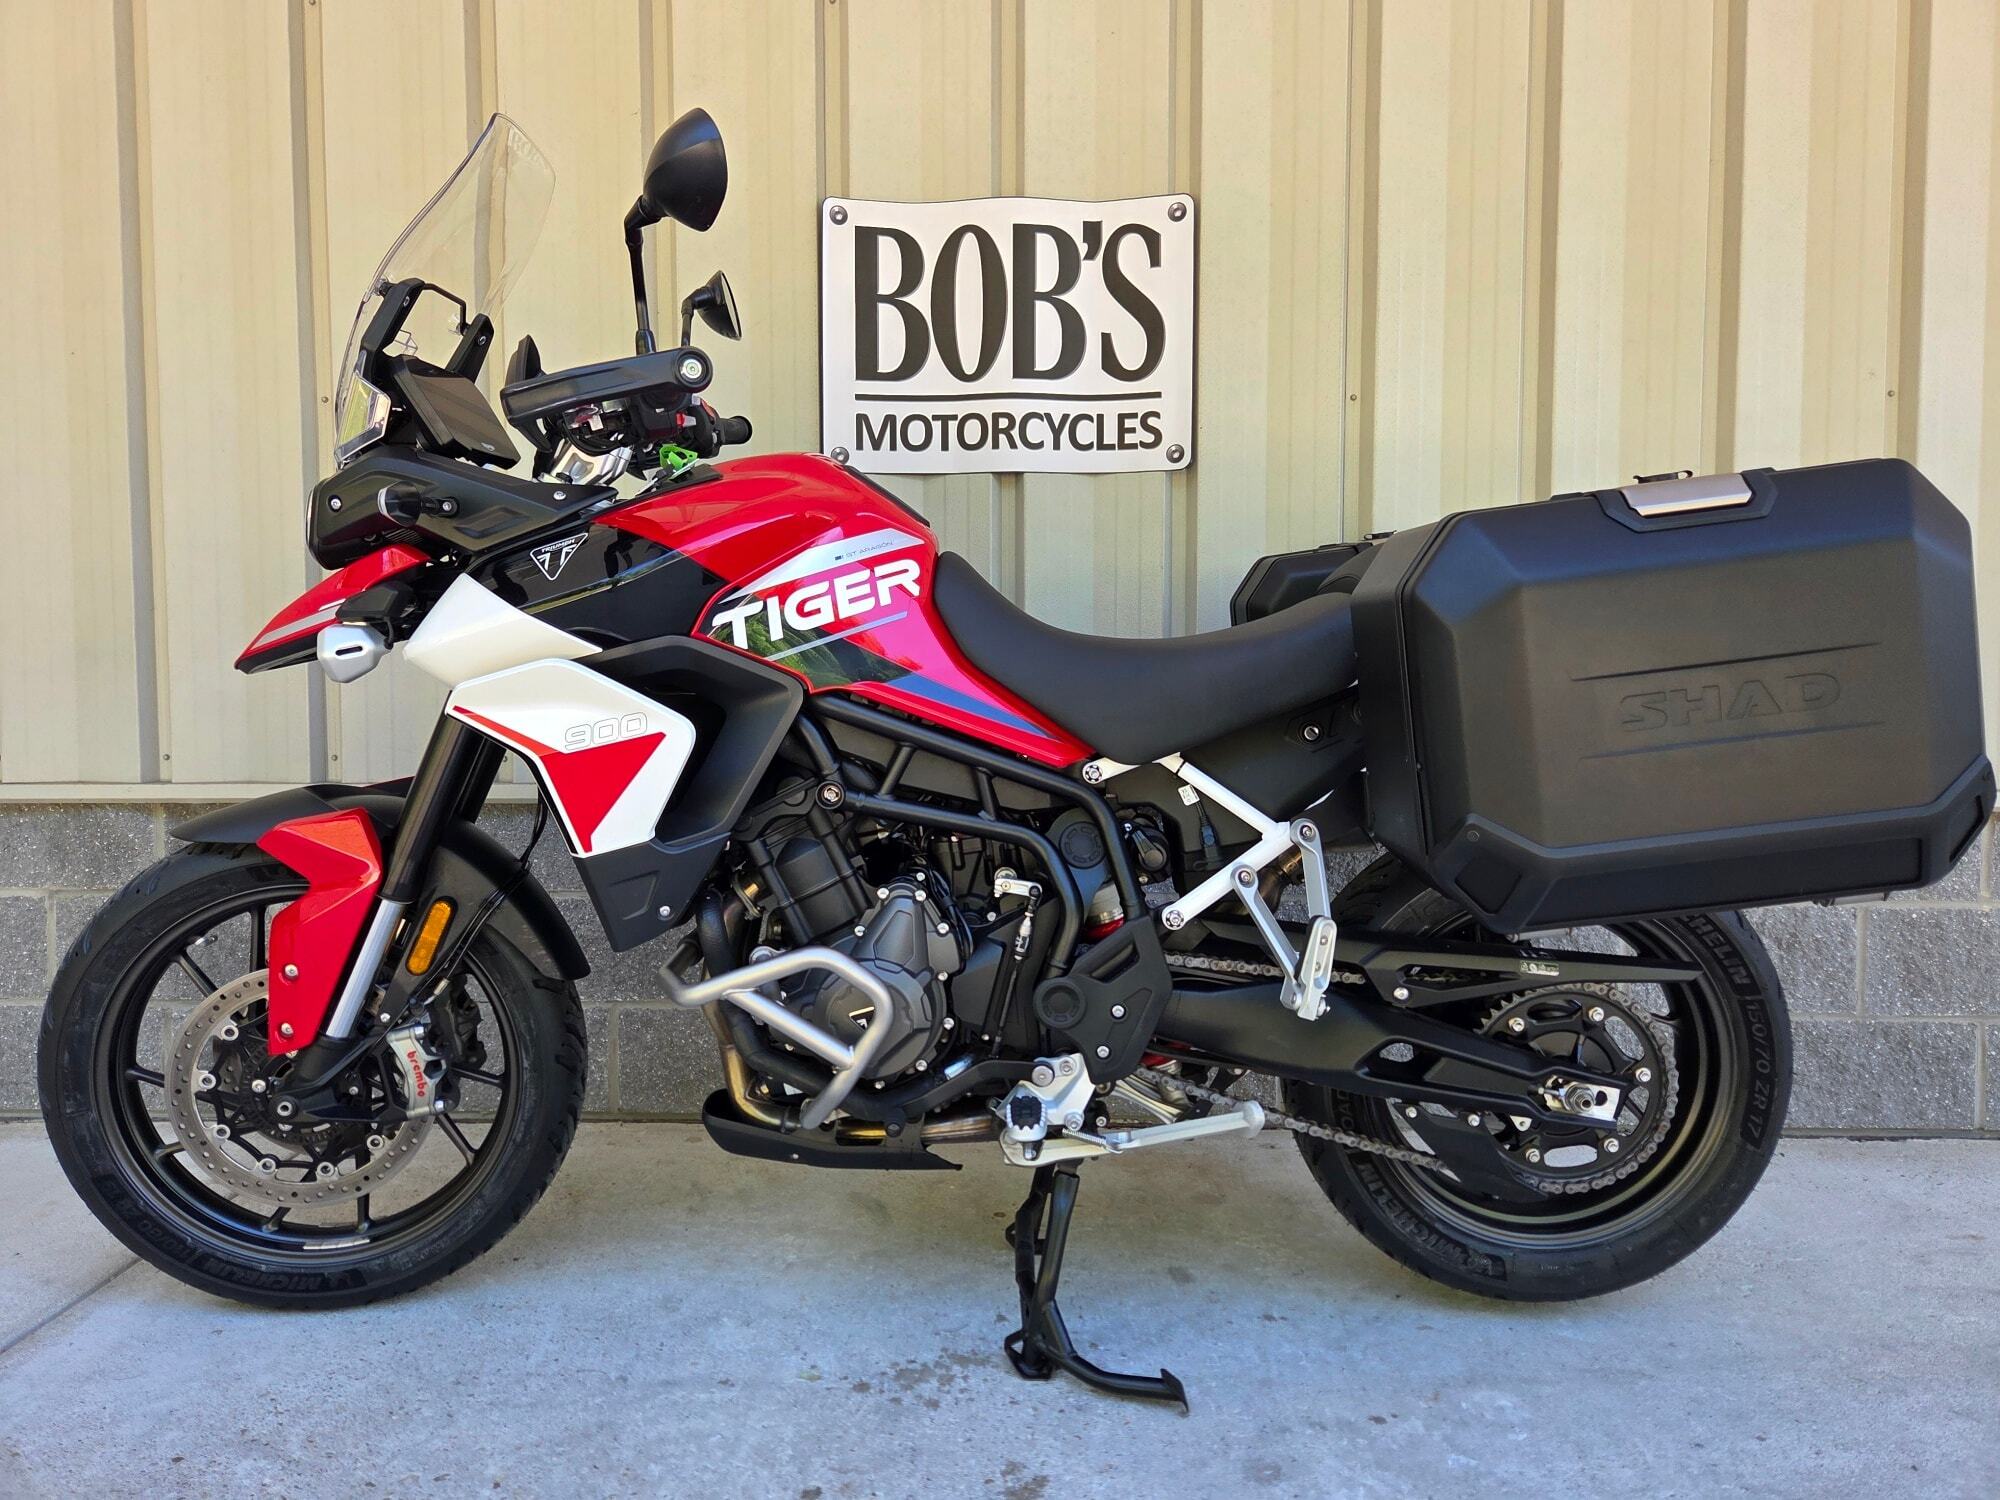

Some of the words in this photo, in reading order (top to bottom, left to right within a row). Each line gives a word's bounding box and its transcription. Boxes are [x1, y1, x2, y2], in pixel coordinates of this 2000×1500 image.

[855, 220, 1166, 382] BOB'S
[855, 411, 1163, 452] MOTORCYCLES
[541, 538, 576, 553] TRIUMPH
[712, 559, 920, 649] TIGER
[1620, 672, 1841, 733] SHAD
[565, 711, 648, 751] 900
[1746, 1000, 1771, 1074] 150/70
[407, 1050, 427, 1097] brembo
[1753, 1079, 1770, 1110] ZR
[1747, 1114, 1762, 1139] 17
[1357, 1162, 1468, 1269] MICHELIN
[203, 1261, 320, 1290] MICHELIN
